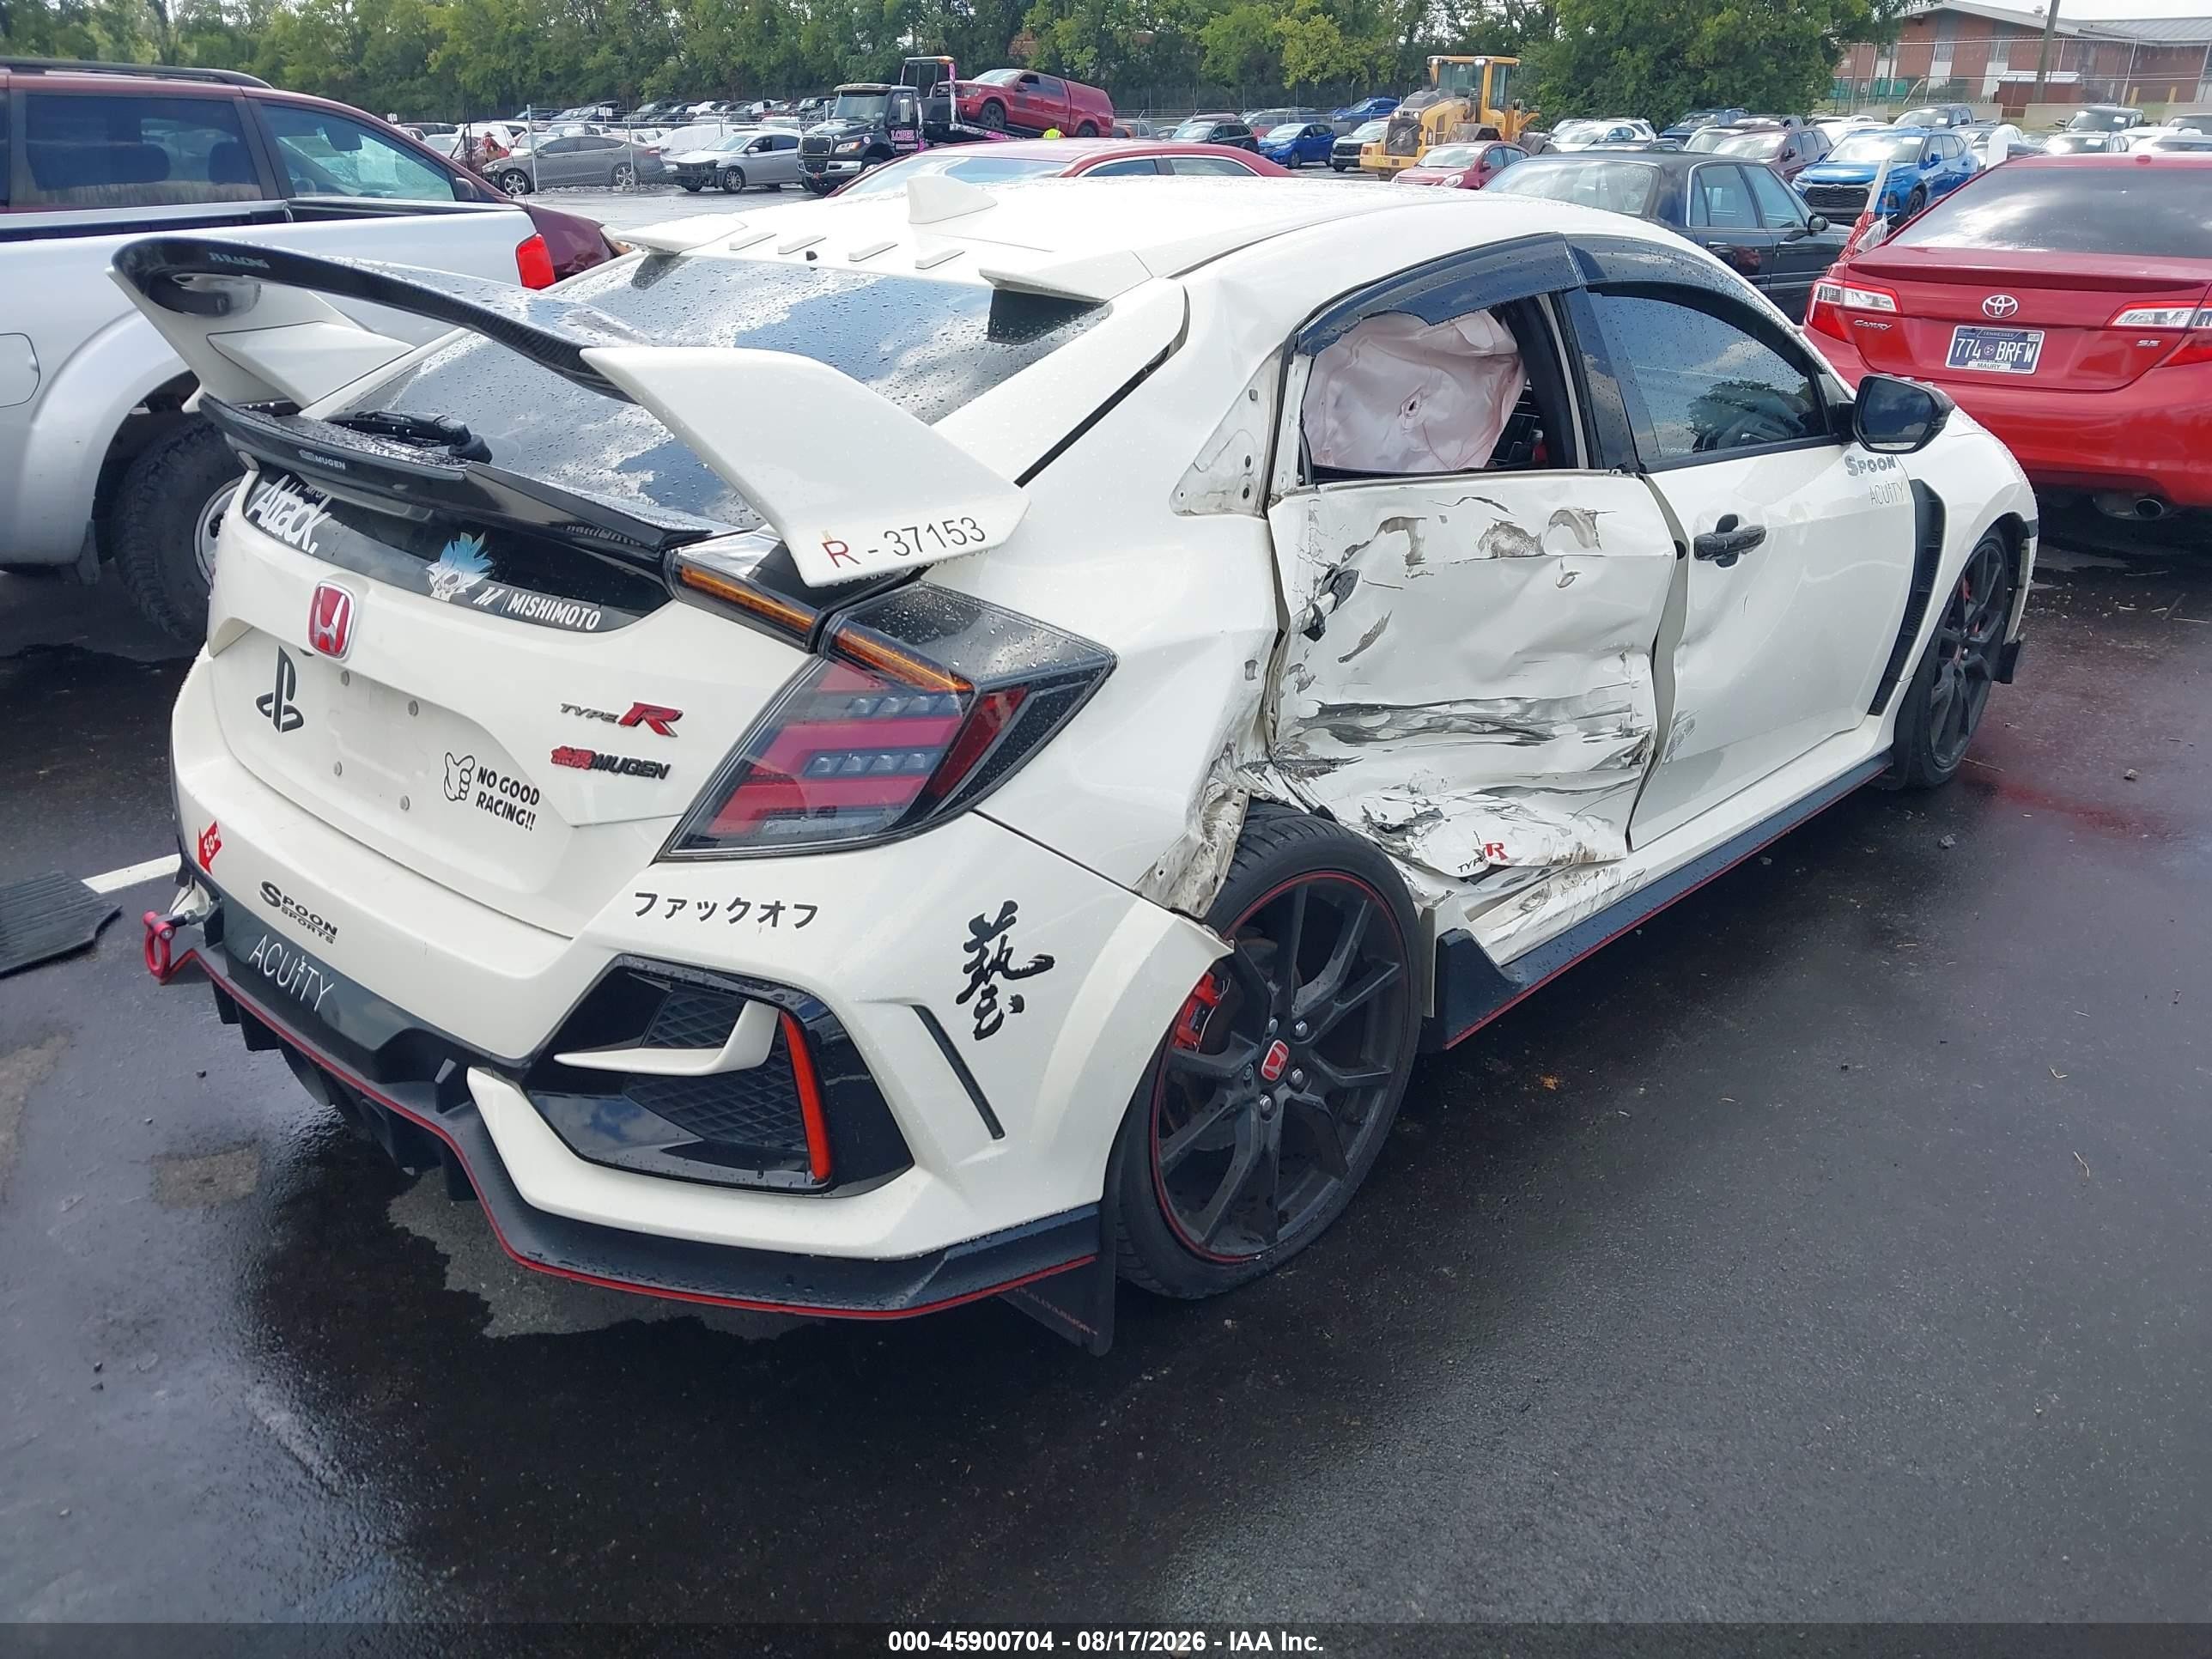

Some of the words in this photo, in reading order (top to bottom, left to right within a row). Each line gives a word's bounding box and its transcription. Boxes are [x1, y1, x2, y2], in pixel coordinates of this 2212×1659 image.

[890, 130, 915, 142] LOPEZ
[1955, 338, 1982, 360] 774
[1994, 341, 2037, 363] BRFW
[1977, 362, 2002, 371] MAURY
[314, 455, 346, 471] MUGEN
[822, 540, 861, 568] R
[884, 517, 986, 556] 37153
[507, 592, 601, 630] MISHIMOTO
[561, 702, 619, 724] TYPE
[617, 702, 684, 738] R
[591, 753, 672, 780] MUGEN
[477, 766, 497, 788] NO
[499, 776, 540, 806] GOOD
[476, 790, 536, 831] RACING!!
[1485, 842, 1509, 860] R
[281, 906, 336, 945] SPORTS
[635, 892, 818, 929] ファックオフ
